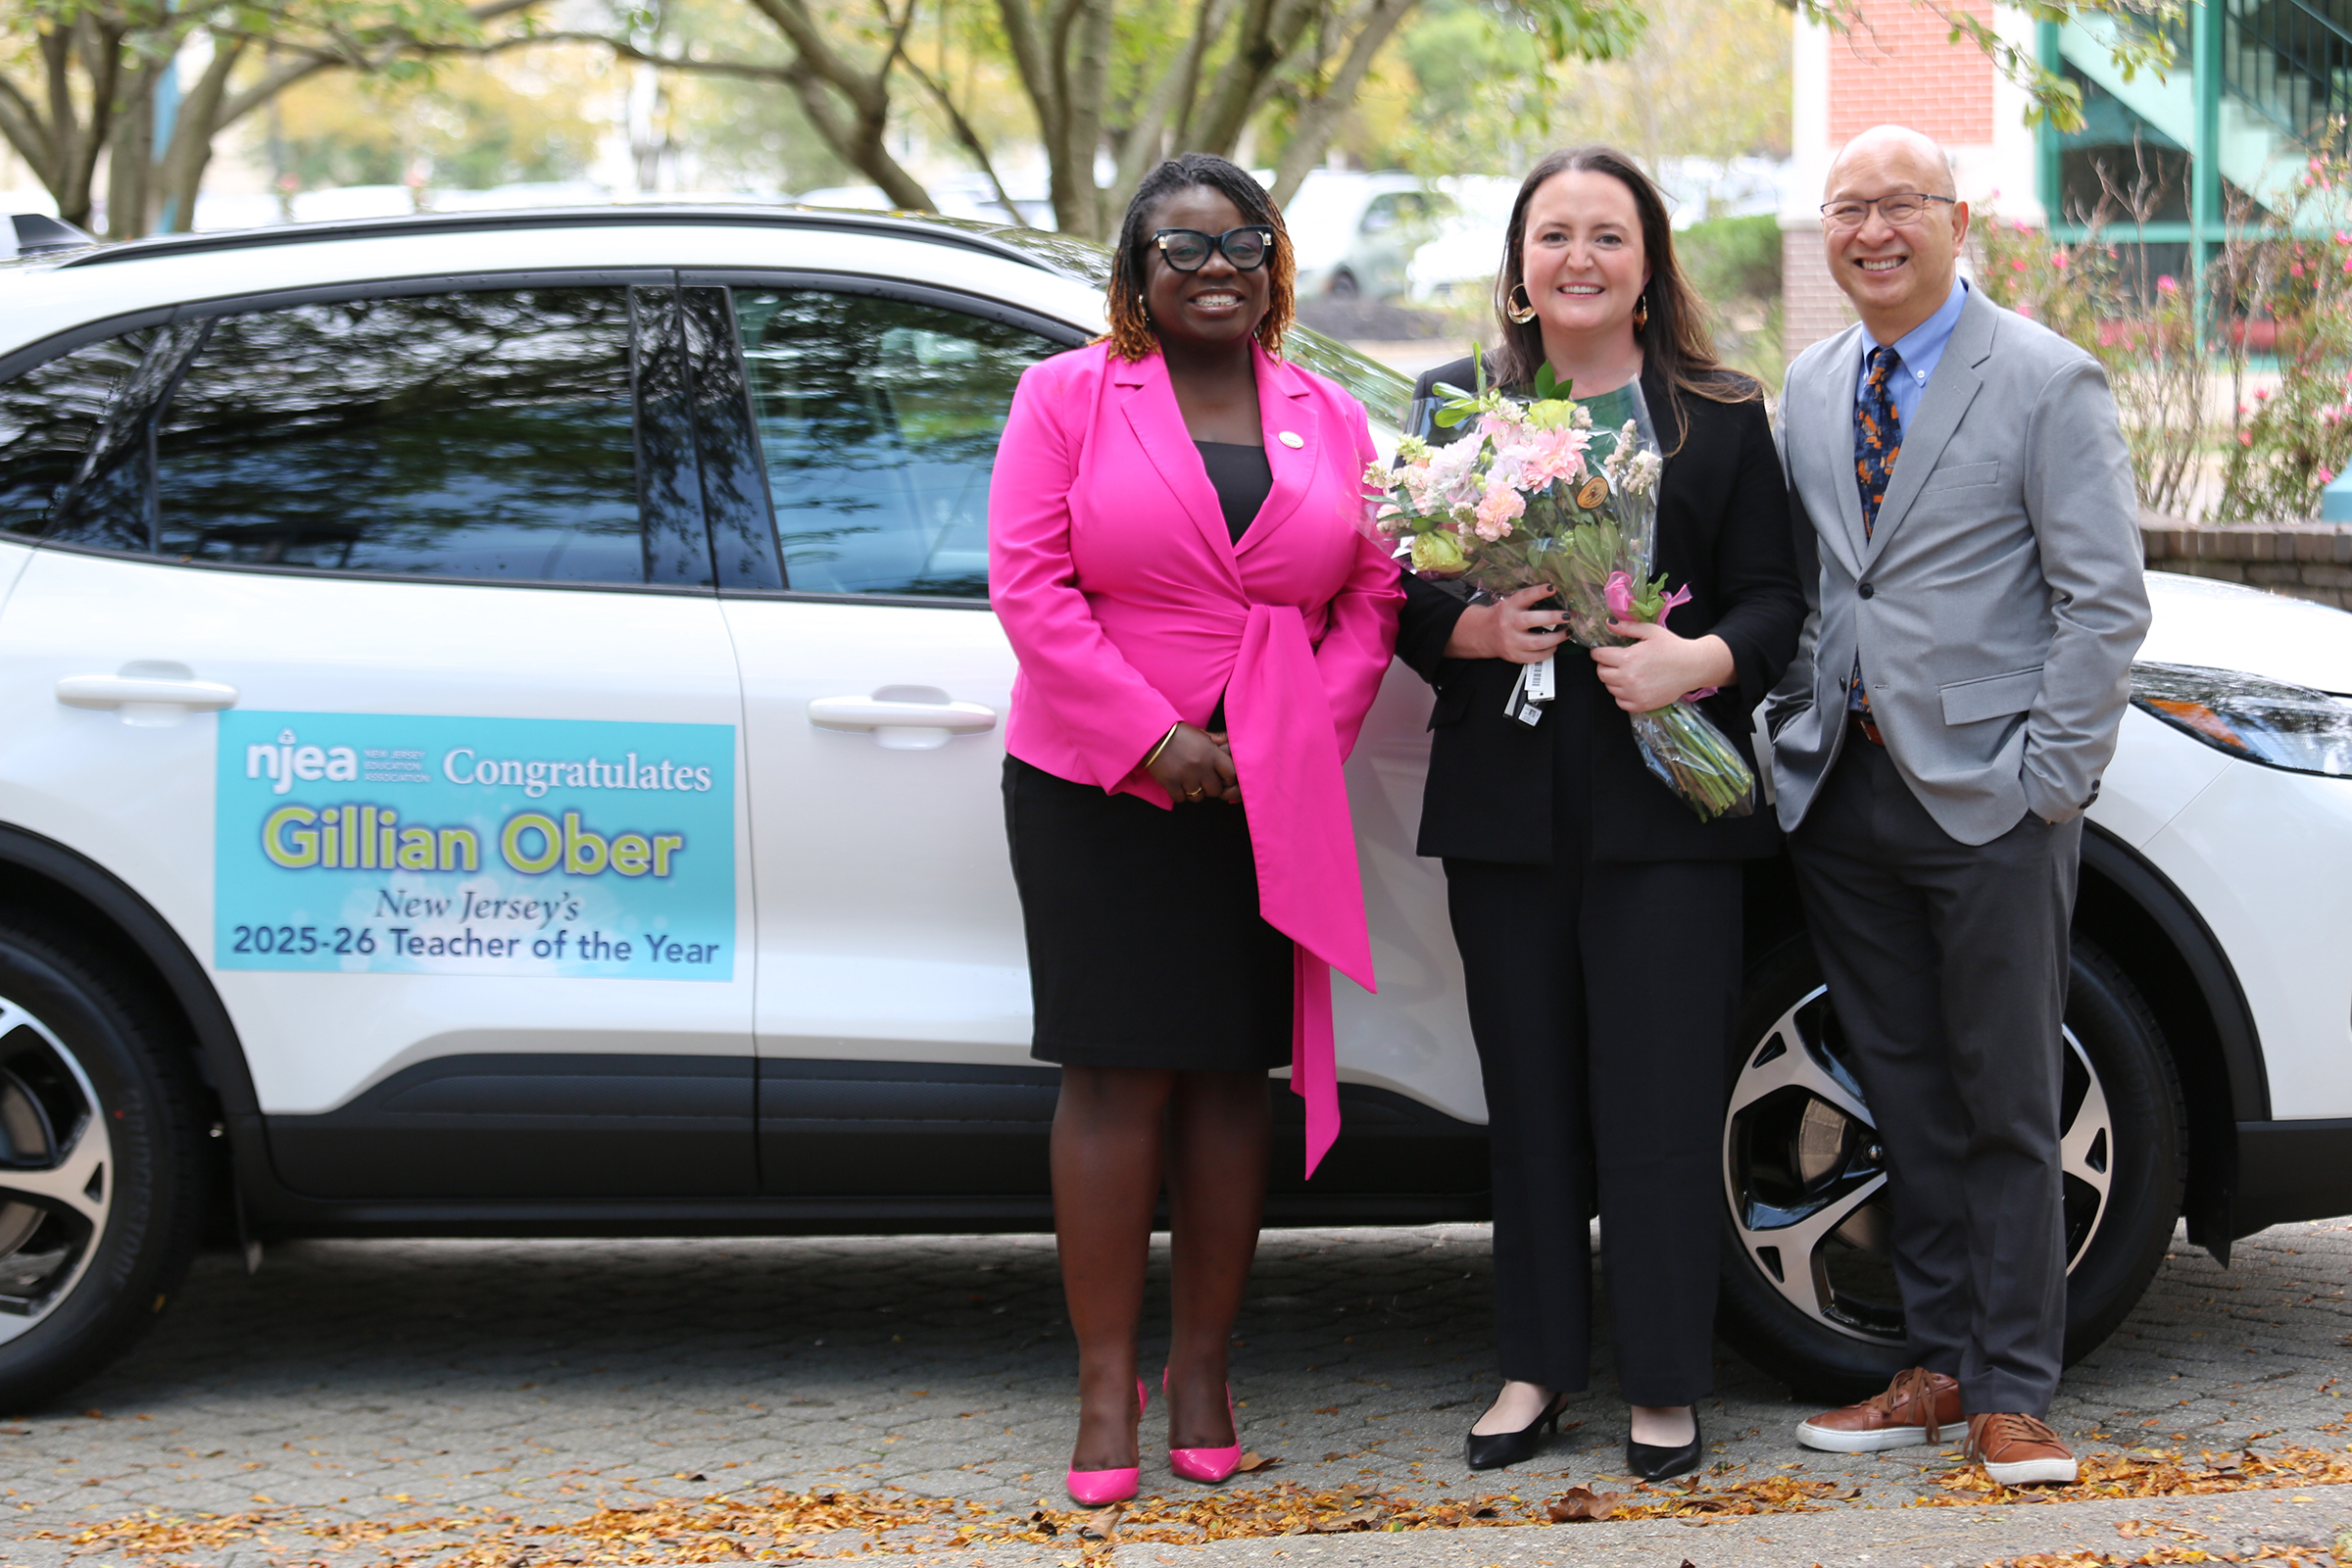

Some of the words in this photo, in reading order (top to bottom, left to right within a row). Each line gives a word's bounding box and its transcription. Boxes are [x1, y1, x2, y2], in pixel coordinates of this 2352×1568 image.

[246, 727, 358, 795] njea
[443, 747, 711, 798] Congratulates
[263, 805, 478, 871] Gillian
[500, 810, 683, 878] Ober
[374, 889, 451, 918] New
[460, 891, 579, 931] Jersey's
[233, 925, 375, 955] 2025-26
[388, 927, 520, 957] Teacher
[532, 929, 567, 959] of
[577, 931, 632, 961] the
[643, 933, 720, 964] Year
